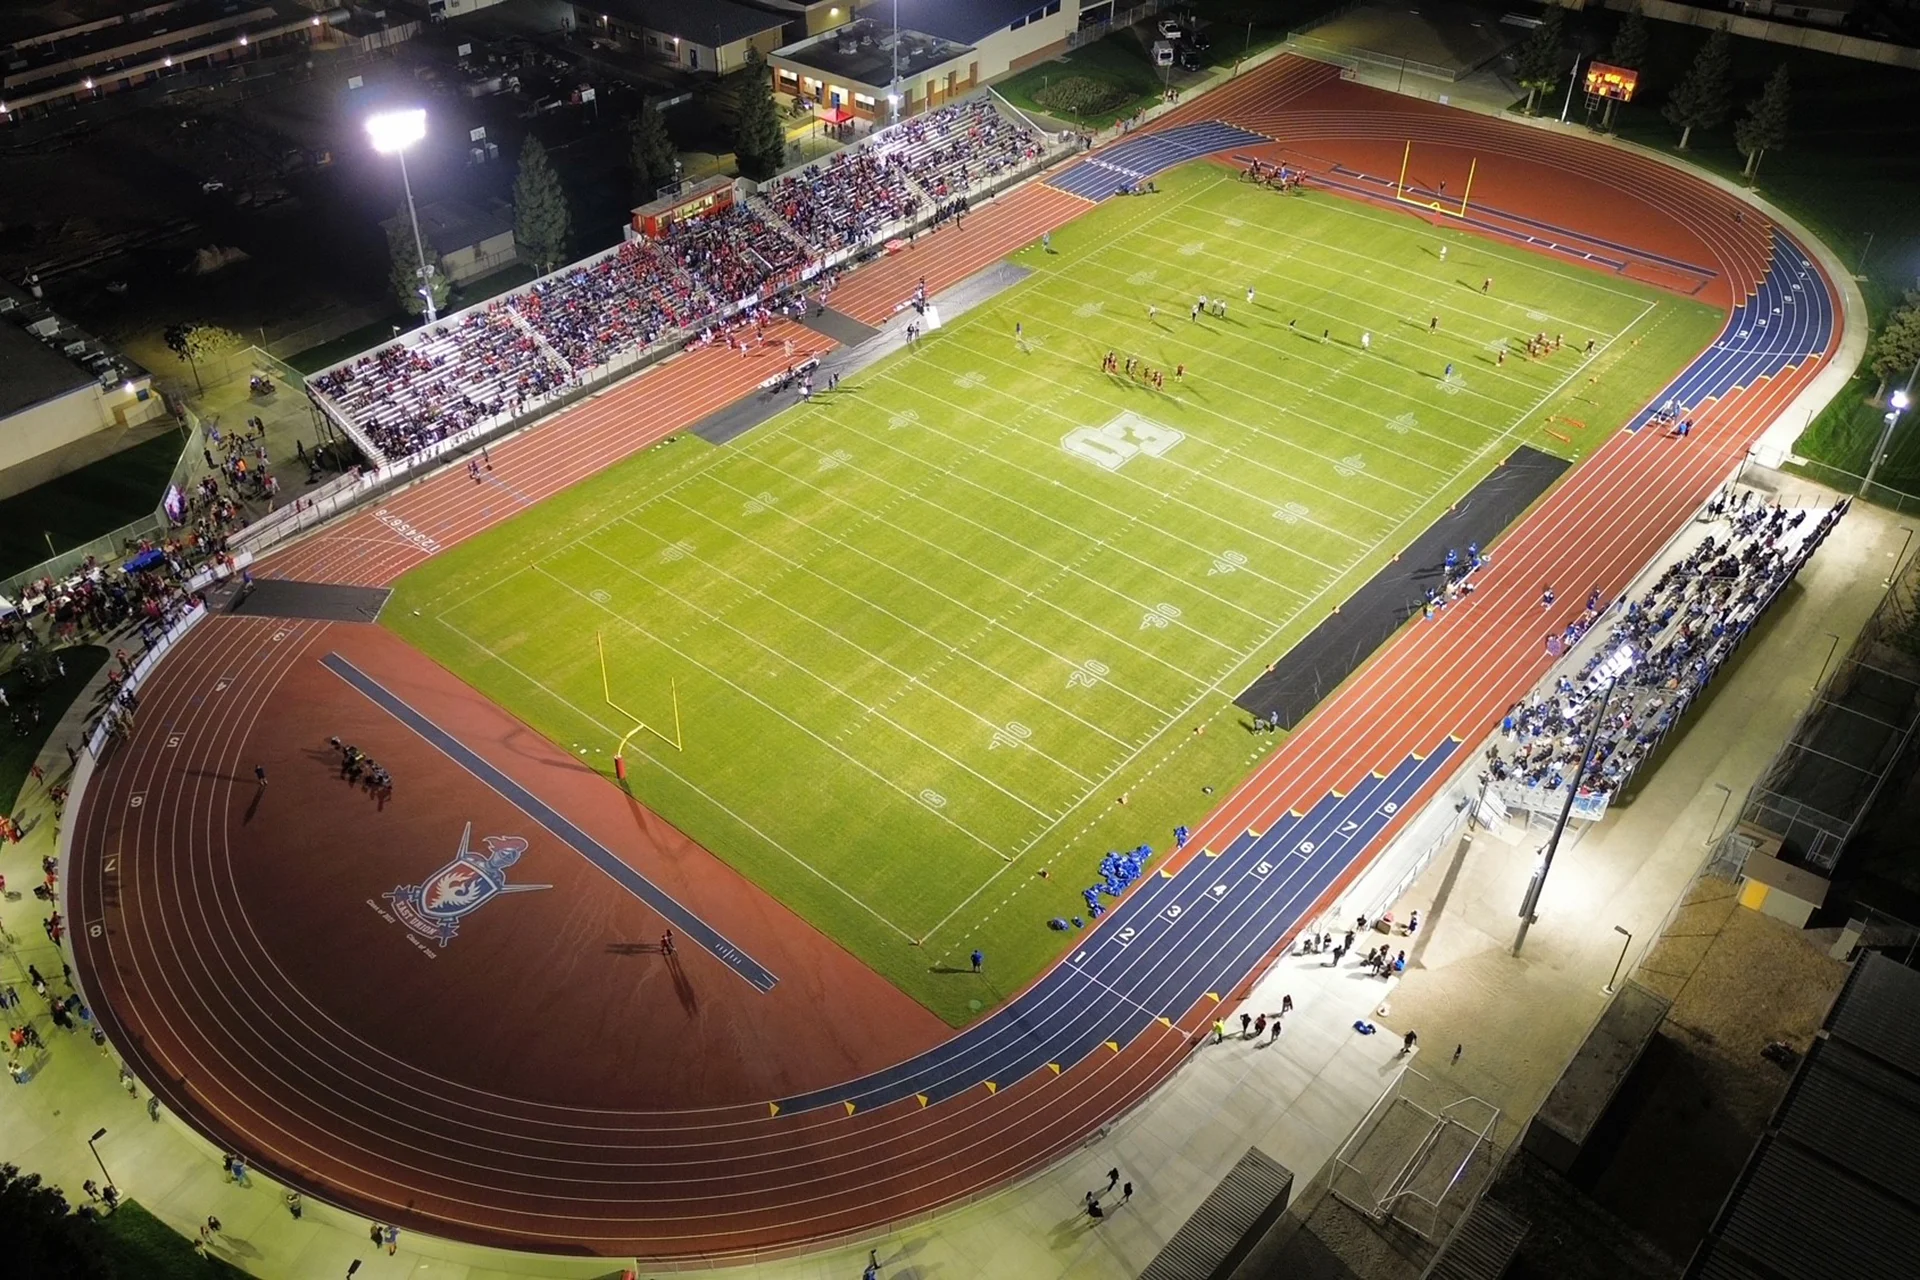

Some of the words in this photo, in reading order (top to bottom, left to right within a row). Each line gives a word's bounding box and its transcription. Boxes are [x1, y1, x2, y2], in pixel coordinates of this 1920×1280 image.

[1334, 456, 1366, 477] 40
[744, 491, 779, 512] 20
[1272, 502, 1309, 523] 50
[662, 541, 696, 560] 10
[1213, 550, 1247, 573] 40
[1143, 603, 1181, 628] 30
[273, 632, 285, 642] 3
[1071, 660, 1110, 688] 20
[215, 682, 227, 691] 4
[995, 722, 1032, 748] 10
[167, 737, 180, 747] 5
[1383, 802, 1397, 814] 8
[1342, 821, 1358, 832] 7
[1300, 841, 1314, 853] 6
[104, 859, 116, 872] 7
[1257, 862, 1272, 874] 5
[1212, 884, 1227, 896] 4
[1167, 906, 1181, 917] 3
[396, 901, 413, 920] EAST
[410, 917, 437, 935] UNION
[90, 925, 102, 937] 8
[1119, 928, 1134, 942] 2
[1074, 951, 1087, 963] 1
